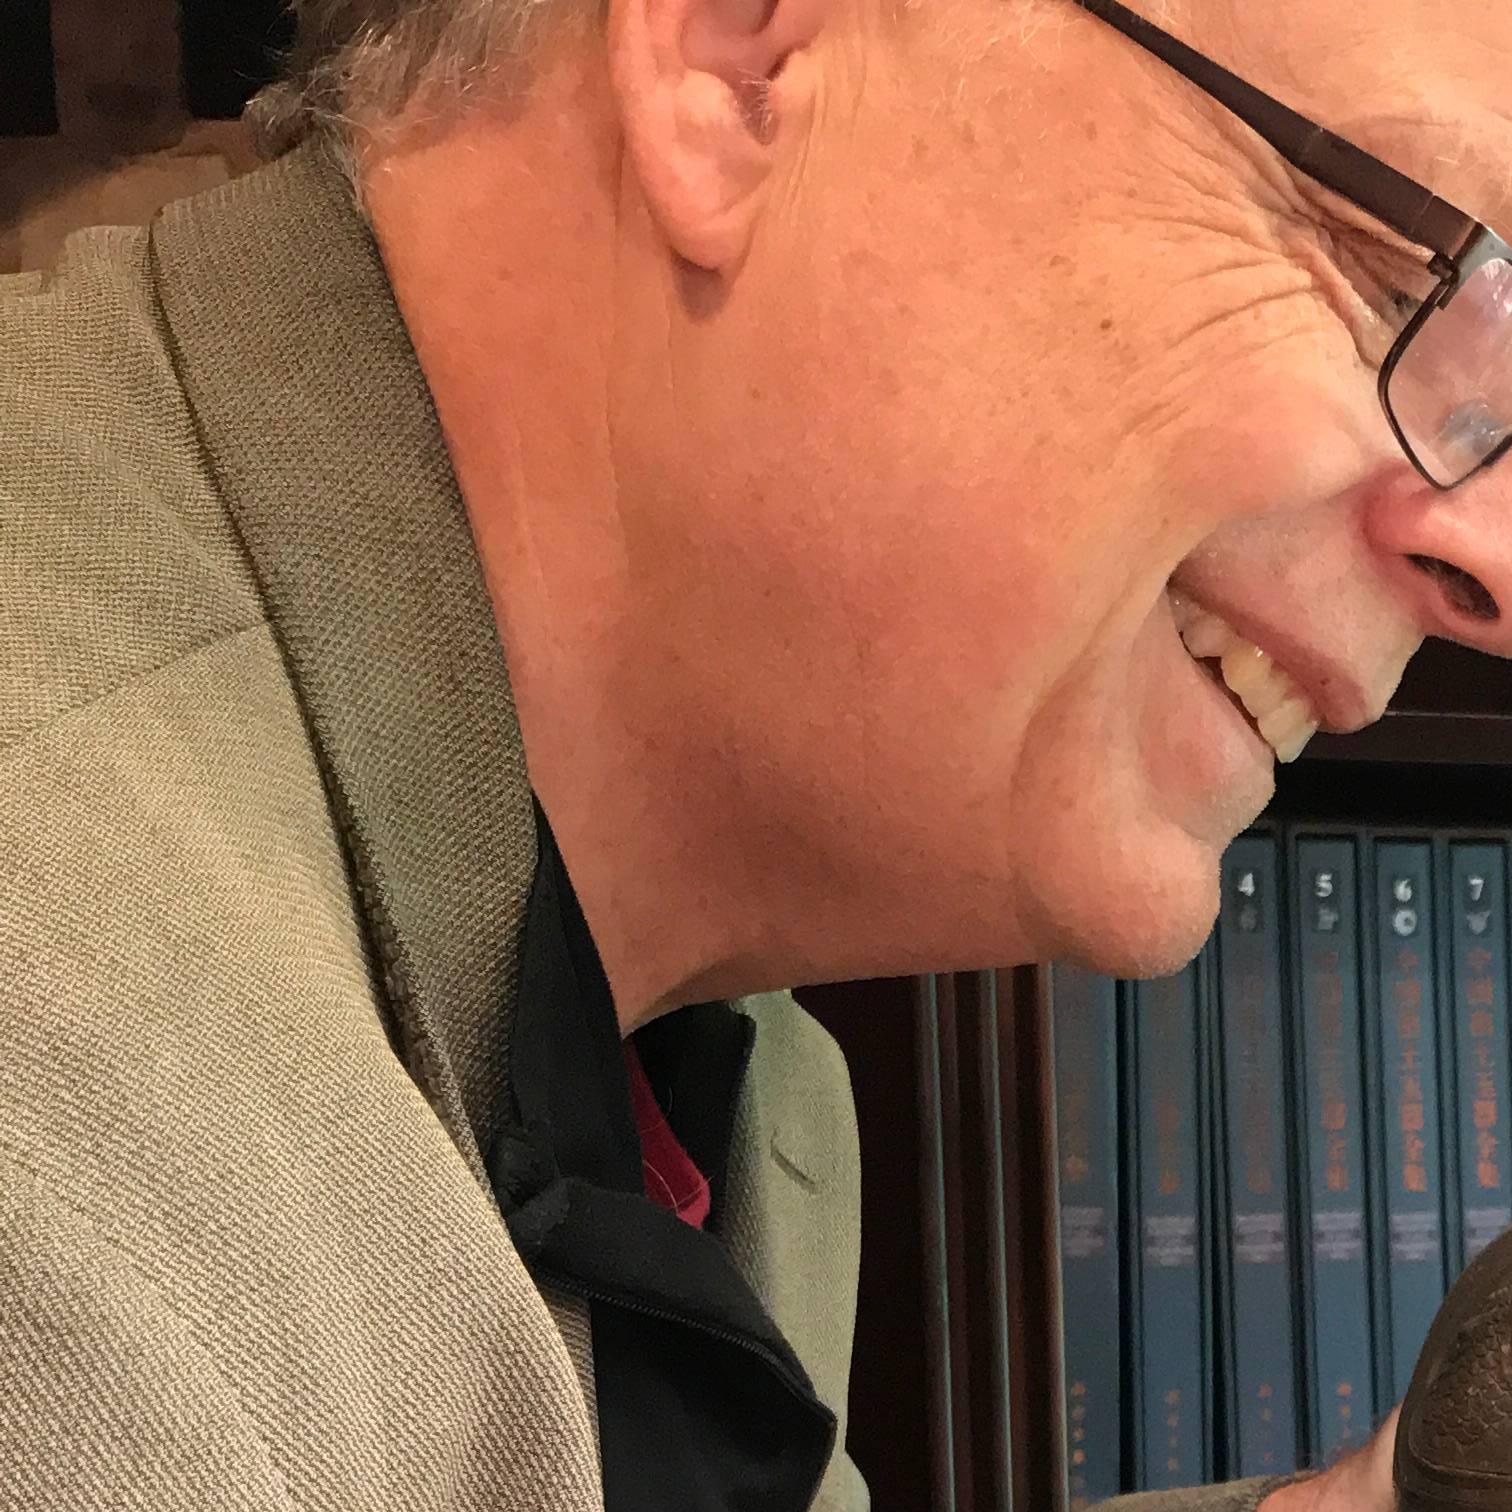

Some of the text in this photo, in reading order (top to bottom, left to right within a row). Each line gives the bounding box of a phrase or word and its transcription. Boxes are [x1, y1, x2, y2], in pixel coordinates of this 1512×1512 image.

[1238, 872, 1256, 898] 4
[1315, 873, 1333, 898] 5
[1394, 878, 1413, 902] 6
[1467, 875, 1484, 901] 7
